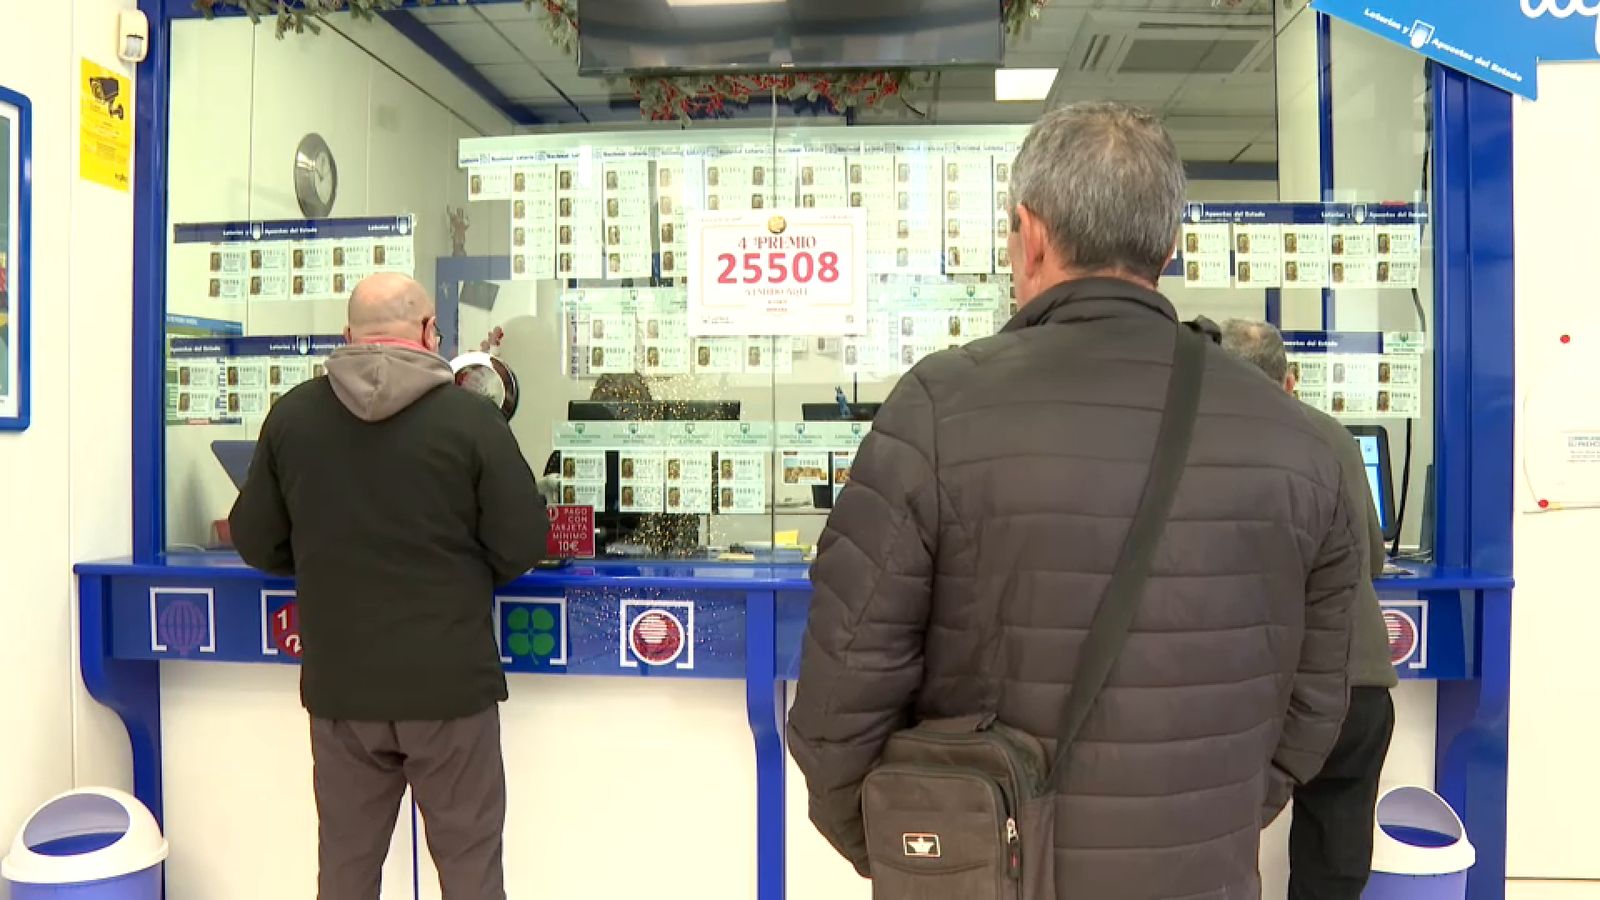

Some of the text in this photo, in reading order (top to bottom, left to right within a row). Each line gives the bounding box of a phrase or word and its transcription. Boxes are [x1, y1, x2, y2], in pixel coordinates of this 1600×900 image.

[1431, 38, 1473, 61] Apuestas
[1475, 56, 1491, 69] del
[1490, 63, 1522, 82] Estado
[1205, 210, 1232, 219] Apuestas
[1245, 210, 1266, 218] Estado
[1369, 211, 1396, 219] Apuestas
[757, 236, 817, 249] PREMIO
[717, 251, 839, 284] 25508
[564, 507, 588, 516] PAGO
[567, 515, 588, 523] CON
[551, 523, 588, 532] TARJETA
[558, 540, 579, 551] 10€
[277, 609, 289, 631] 1
